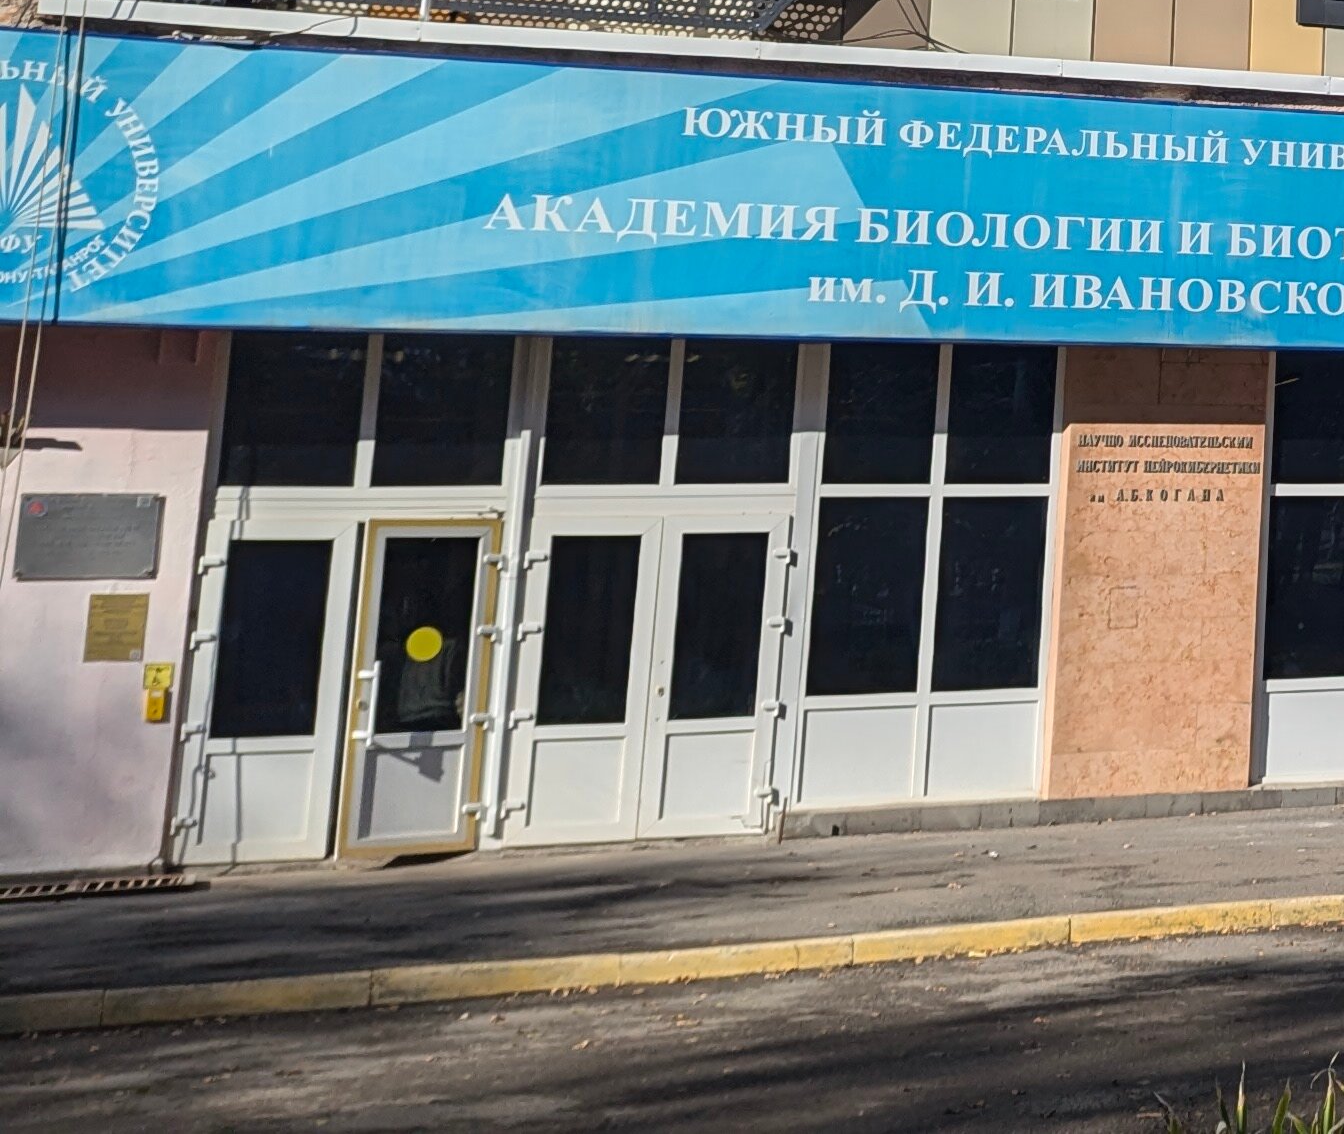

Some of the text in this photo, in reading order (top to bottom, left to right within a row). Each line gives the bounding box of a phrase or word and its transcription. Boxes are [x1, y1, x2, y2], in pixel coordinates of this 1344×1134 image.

[681, 106, 886, 146] ЮЖНЫЙ
[900, 119, 1229, 164] ФЕДЕРАЛЬНЫЙ
[66, 97, 160, 293] УНИВЕРСИТЕТ
[483, 193, 838, 243] АКАДЕМИЯ
[854, 207, 1164, 254] БИОЛОГИИ
[1176, 220, 1214, 256] И
[807, 275, 886, 305] им.
[899, 269, 949, 313] Д.
[964, 271, 1015, 308] И.
[1076, 459, 1140, 474] ИНСТИТУТ
